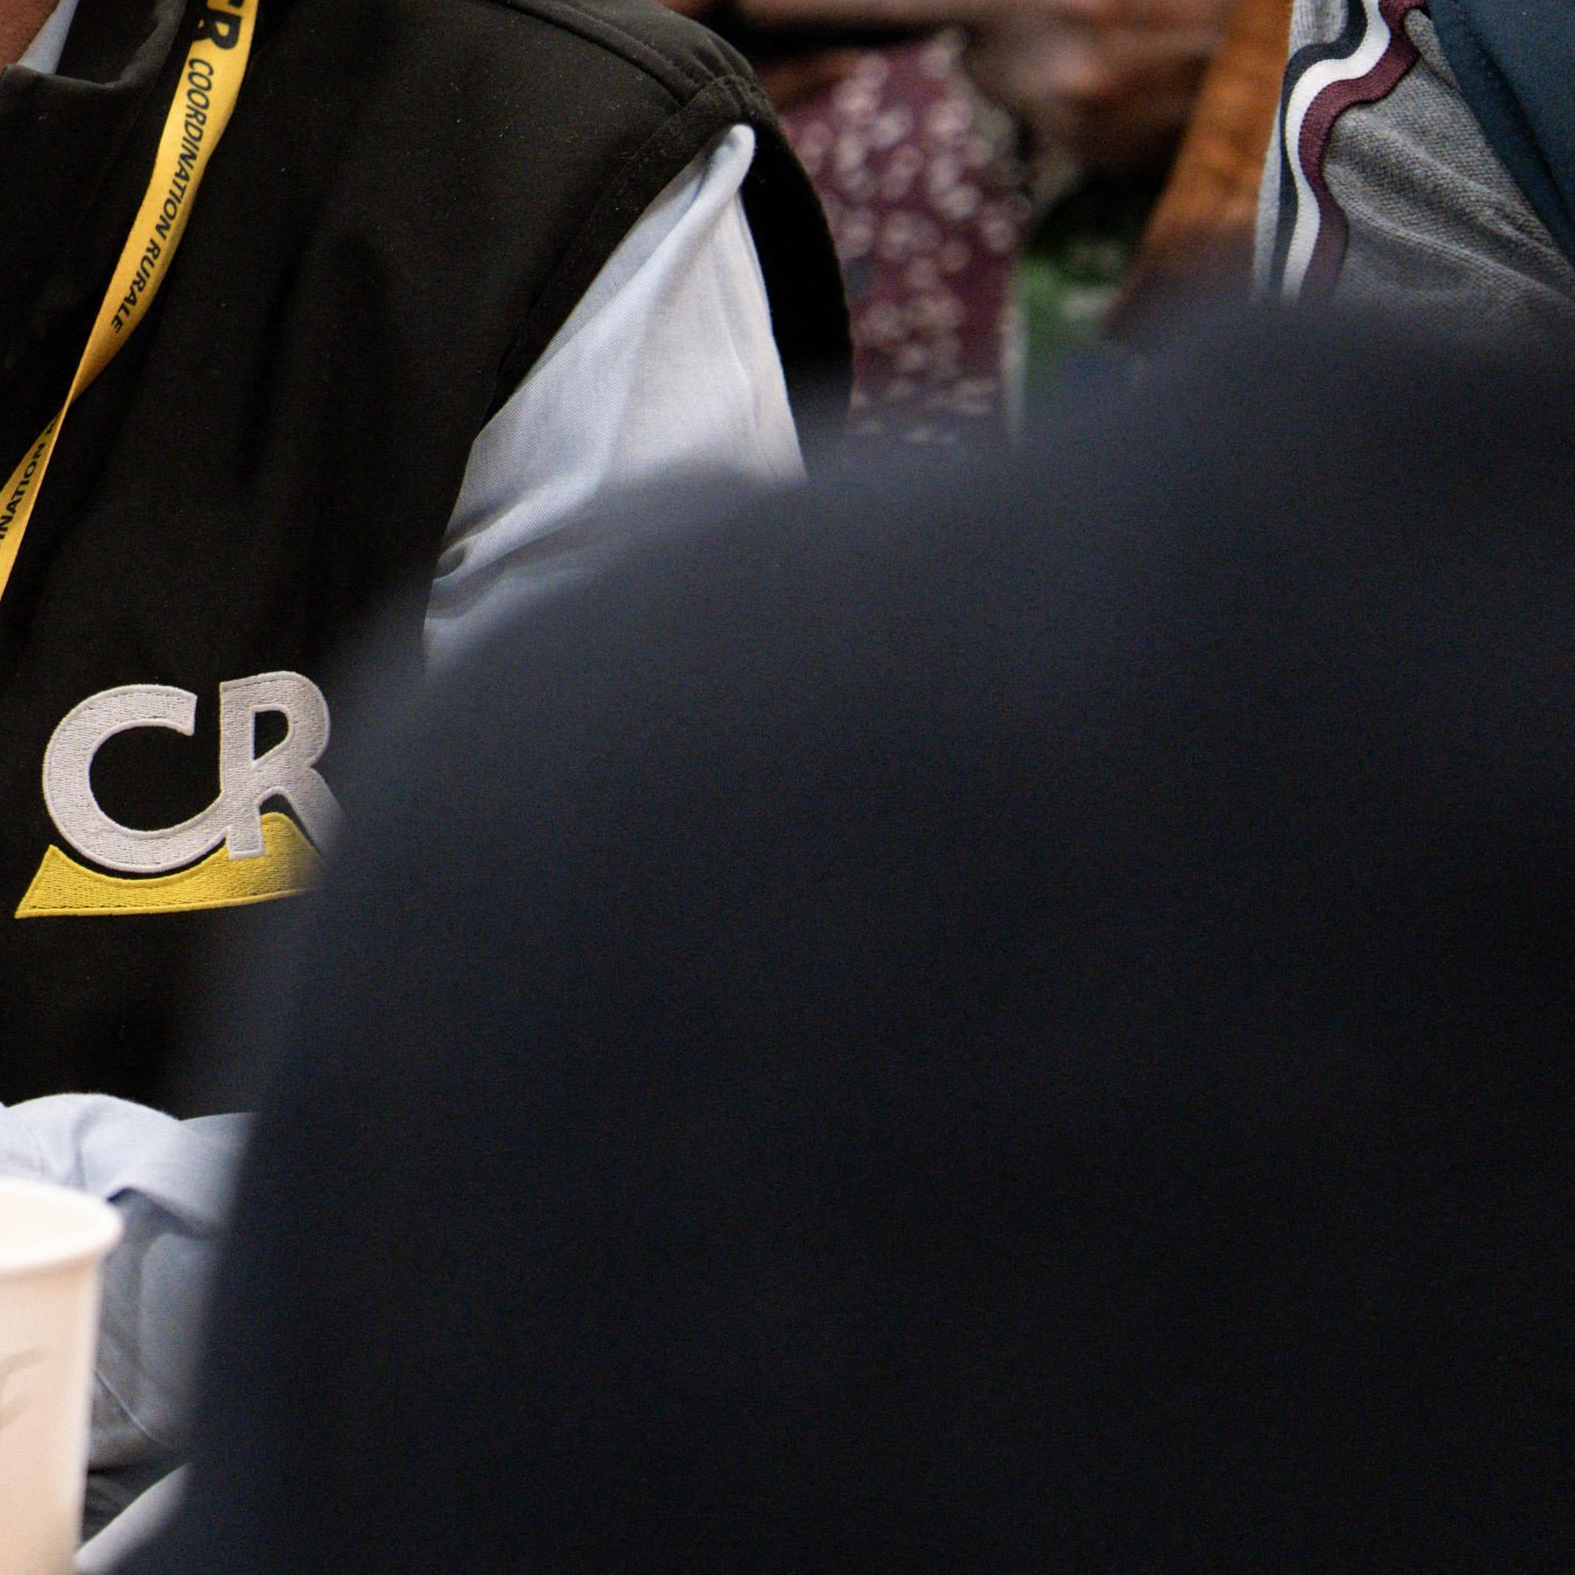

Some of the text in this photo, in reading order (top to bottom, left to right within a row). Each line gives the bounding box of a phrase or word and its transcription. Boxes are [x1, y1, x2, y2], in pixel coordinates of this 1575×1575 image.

[154, 57, 215, 242] COORDINATION
[111, 237, 162, 334] RURALE
[42, 670, 346, 873] CR
